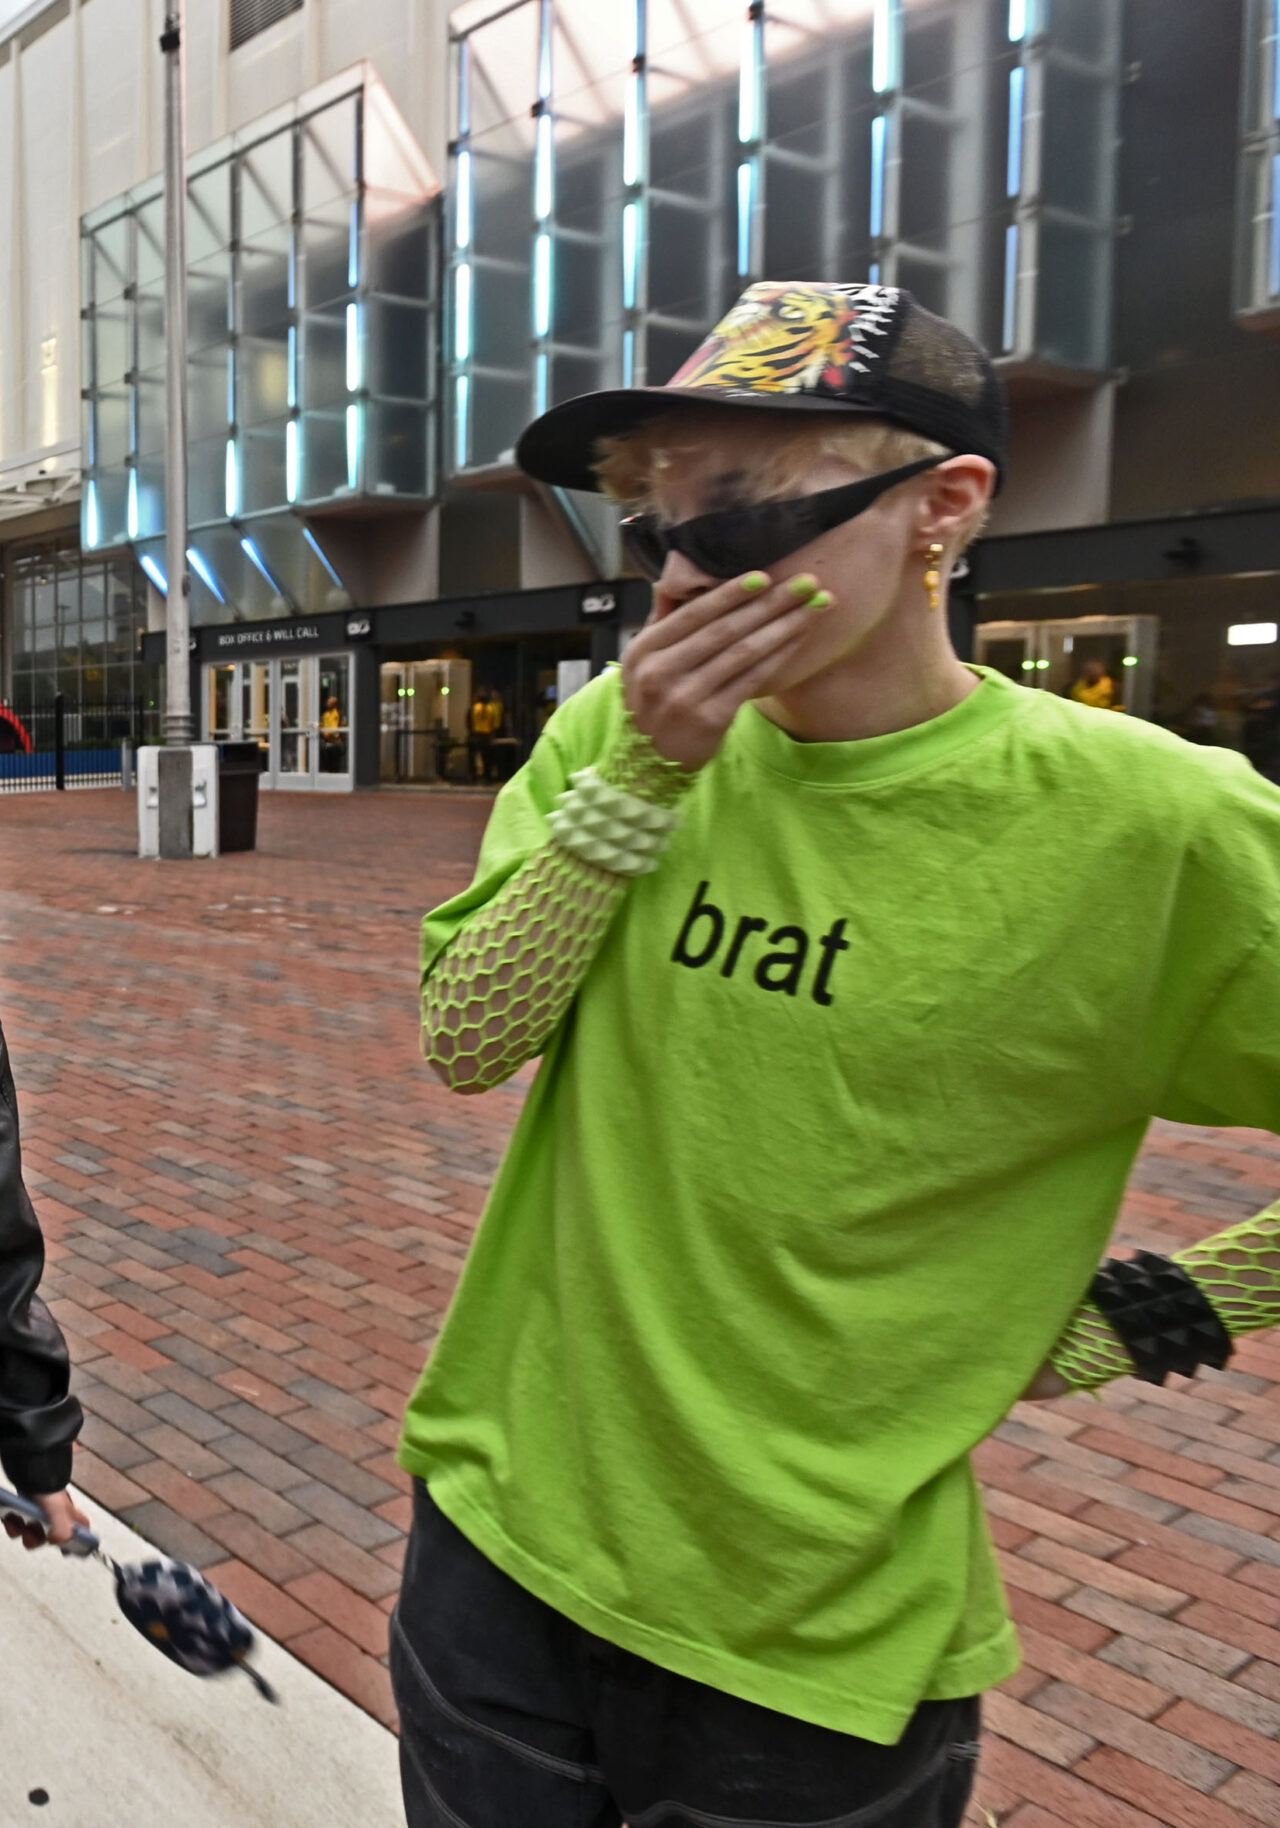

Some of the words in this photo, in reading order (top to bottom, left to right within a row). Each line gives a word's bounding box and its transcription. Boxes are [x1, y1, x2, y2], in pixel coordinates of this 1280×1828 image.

[218, 634, 235, 646] BOX
[237, 631, 263, 644] OFFICE
[273, 627, 294, 640] WILL
[296, 625, 319, 639] CALL
[671, 880, 850, 1006] brat
